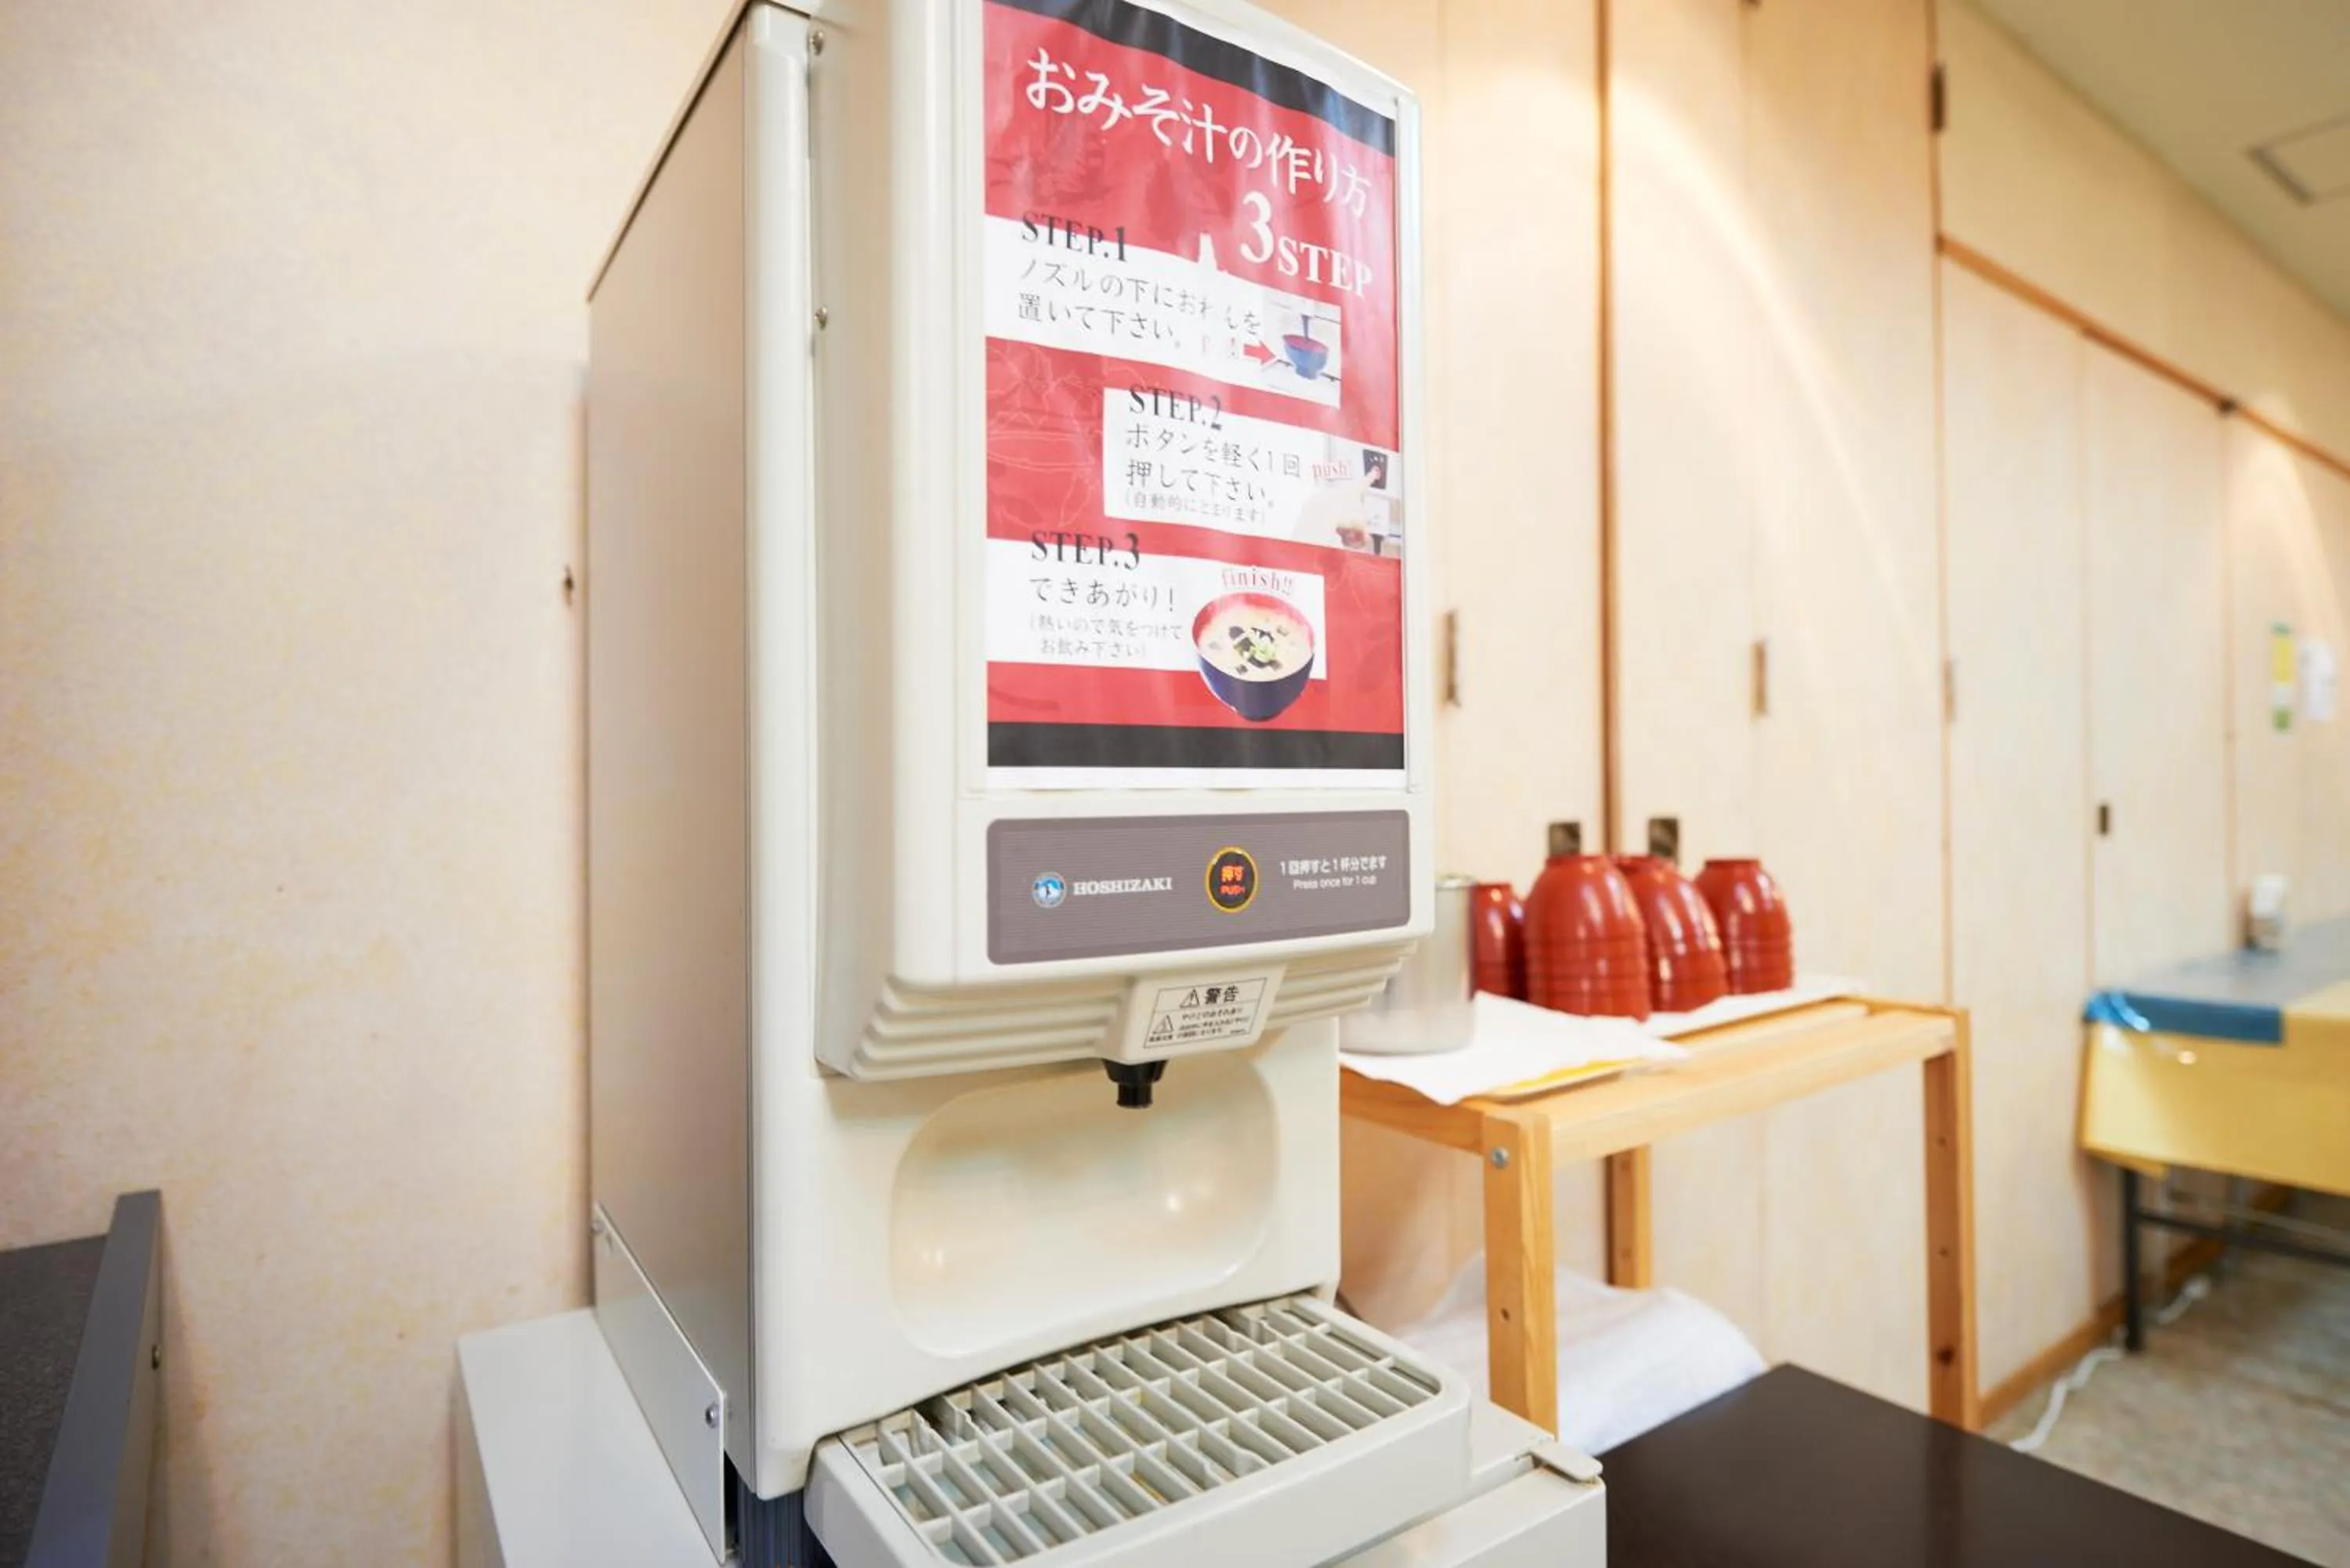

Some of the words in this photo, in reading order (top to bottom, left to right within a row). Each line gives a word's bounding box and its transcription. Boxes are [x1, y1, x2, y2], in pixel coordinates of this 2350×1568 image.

[1025, 47, 1372, 219] おみそ汁の作り方
[1021, 210, 1126, 262] STEP.1
[1018, 292, 1180, 349] 置いて下さい。
[1129, 384, 1222, 431] STEP.2
[1126, 458, 1274, 507] 押して下さい。
[1031, 529, 1140, 571] STEP.3
[1072, 876, 1173, 896] HOSHIZAKI
[1293, 879, 1318, 890] Press
[1320, 877, 1340, 888] once
[1342, 876, 1354, 886] for
[1361, 875, 1377, 886] cup
[1205, 985, 1239, 1005] 警告
